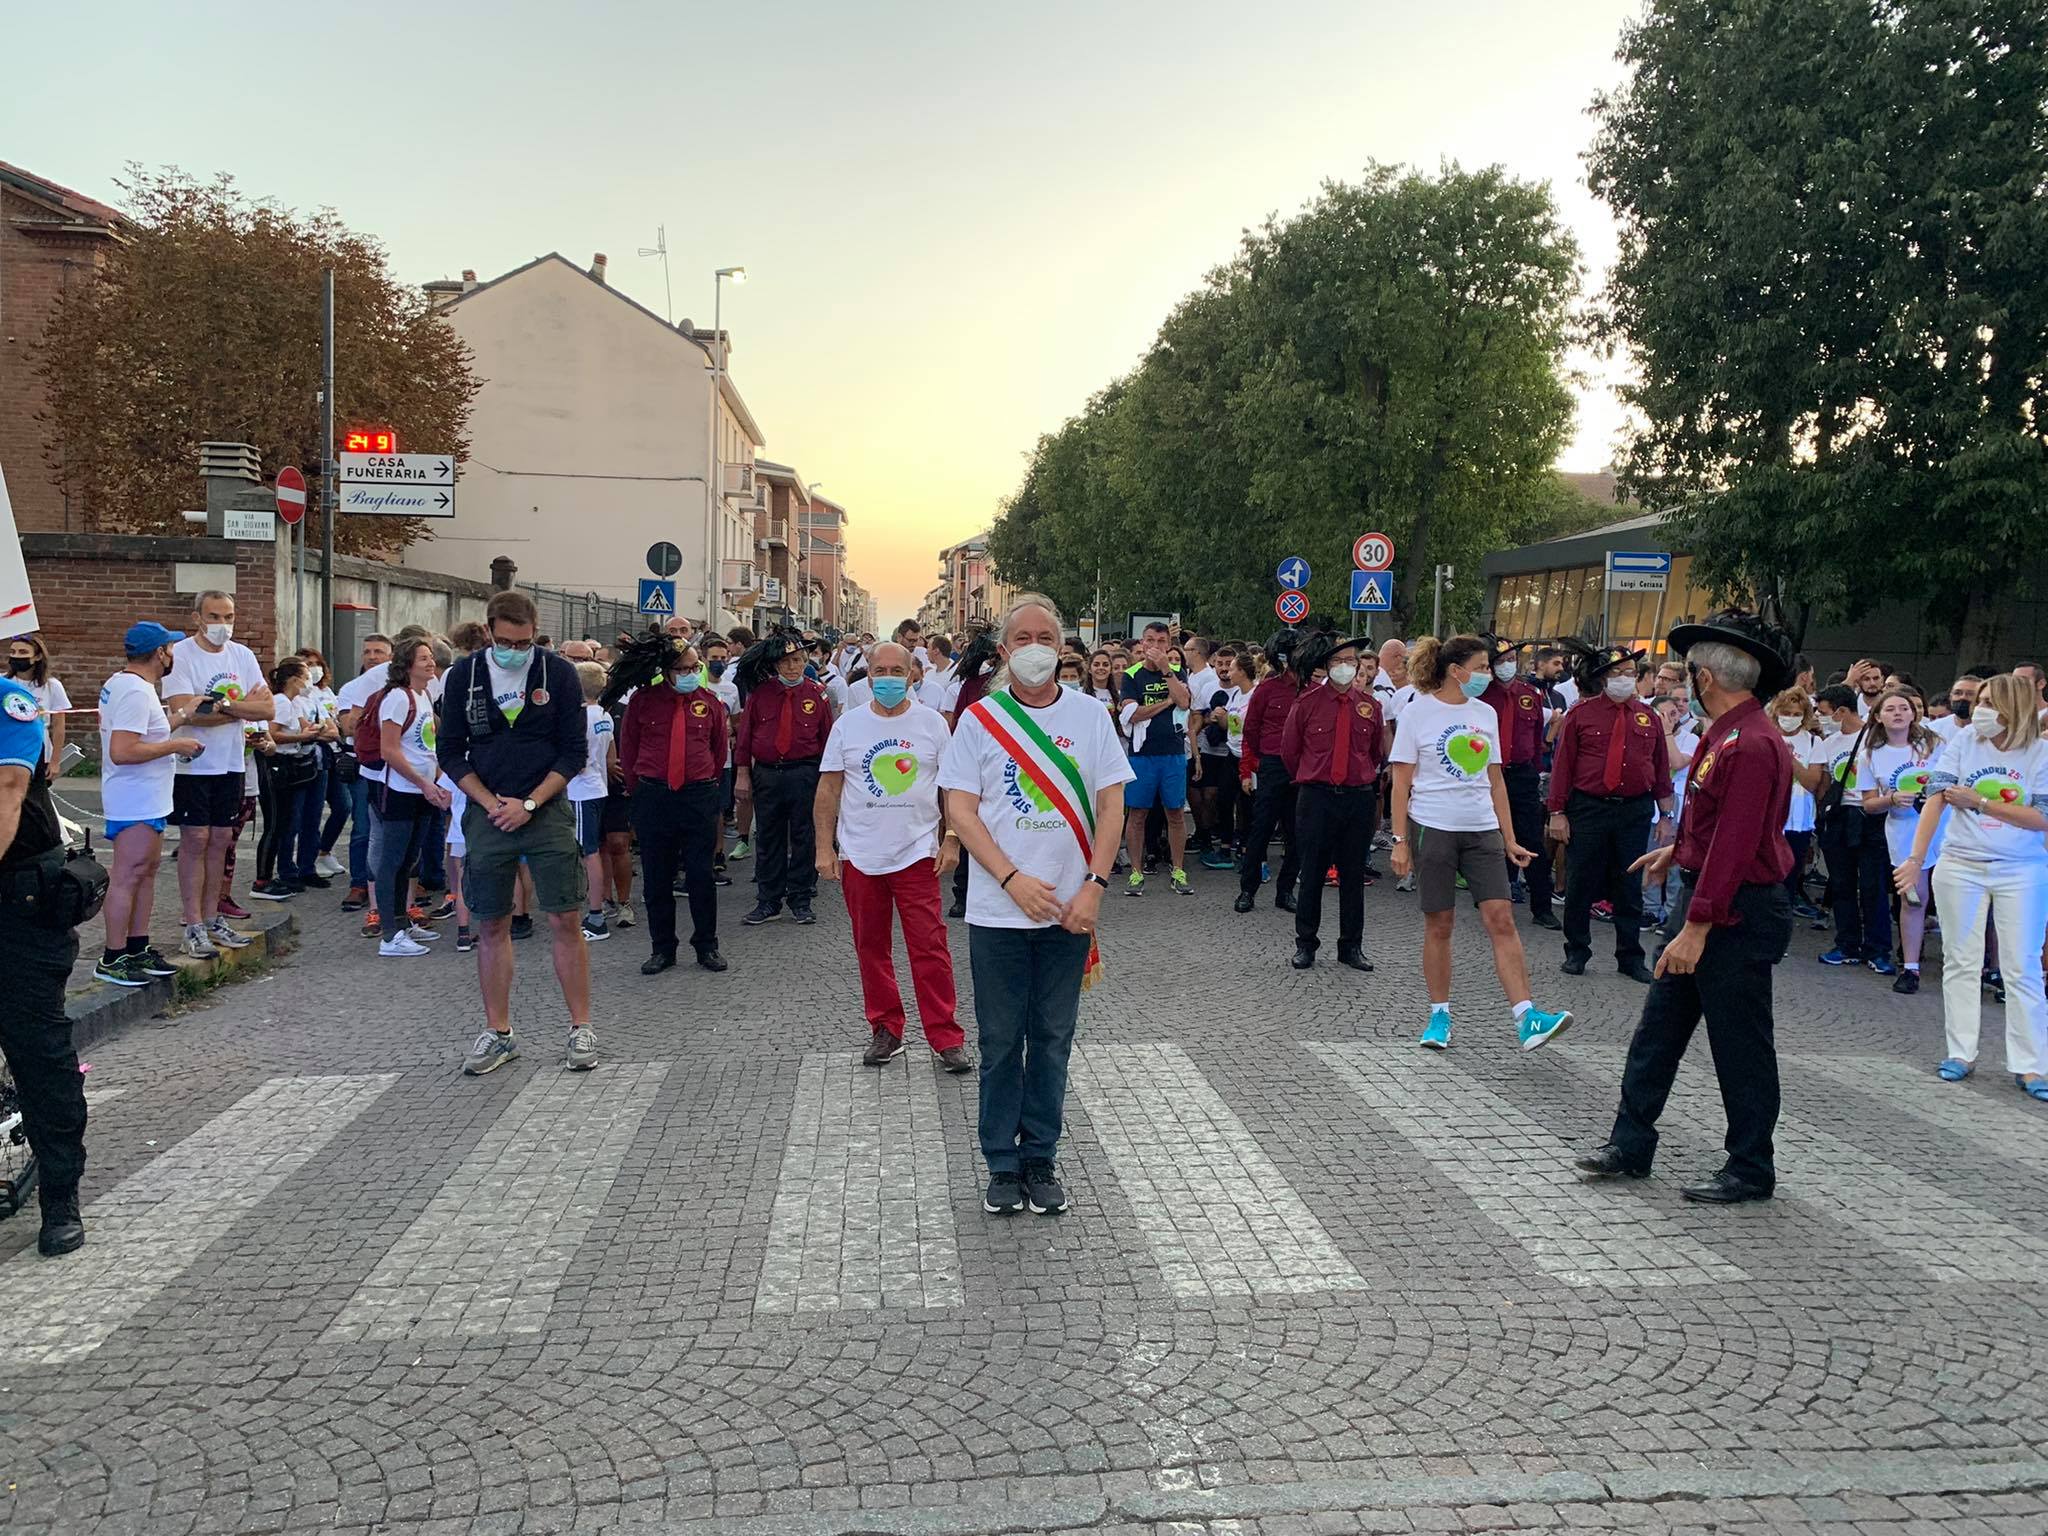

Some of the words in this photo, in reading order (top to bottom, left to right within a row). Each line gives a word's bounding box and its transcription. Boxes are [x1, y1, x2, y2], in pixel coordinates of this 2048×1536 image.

[348, 434, 368, 449] 24
[377, 435, 388, 450] 9
[367, 456, 405, 468] CASA
[347, 467, 426, 479] FUNERARIA
[346, 490, 427, 511] Bagliano
[1363, 544, 1385, 562] 30
[1620, 580, 1636, 589] Luigi
[861, 738, 899, 798] STRALESSANDRIA
[1530, 1020, 1542, 1032] N
